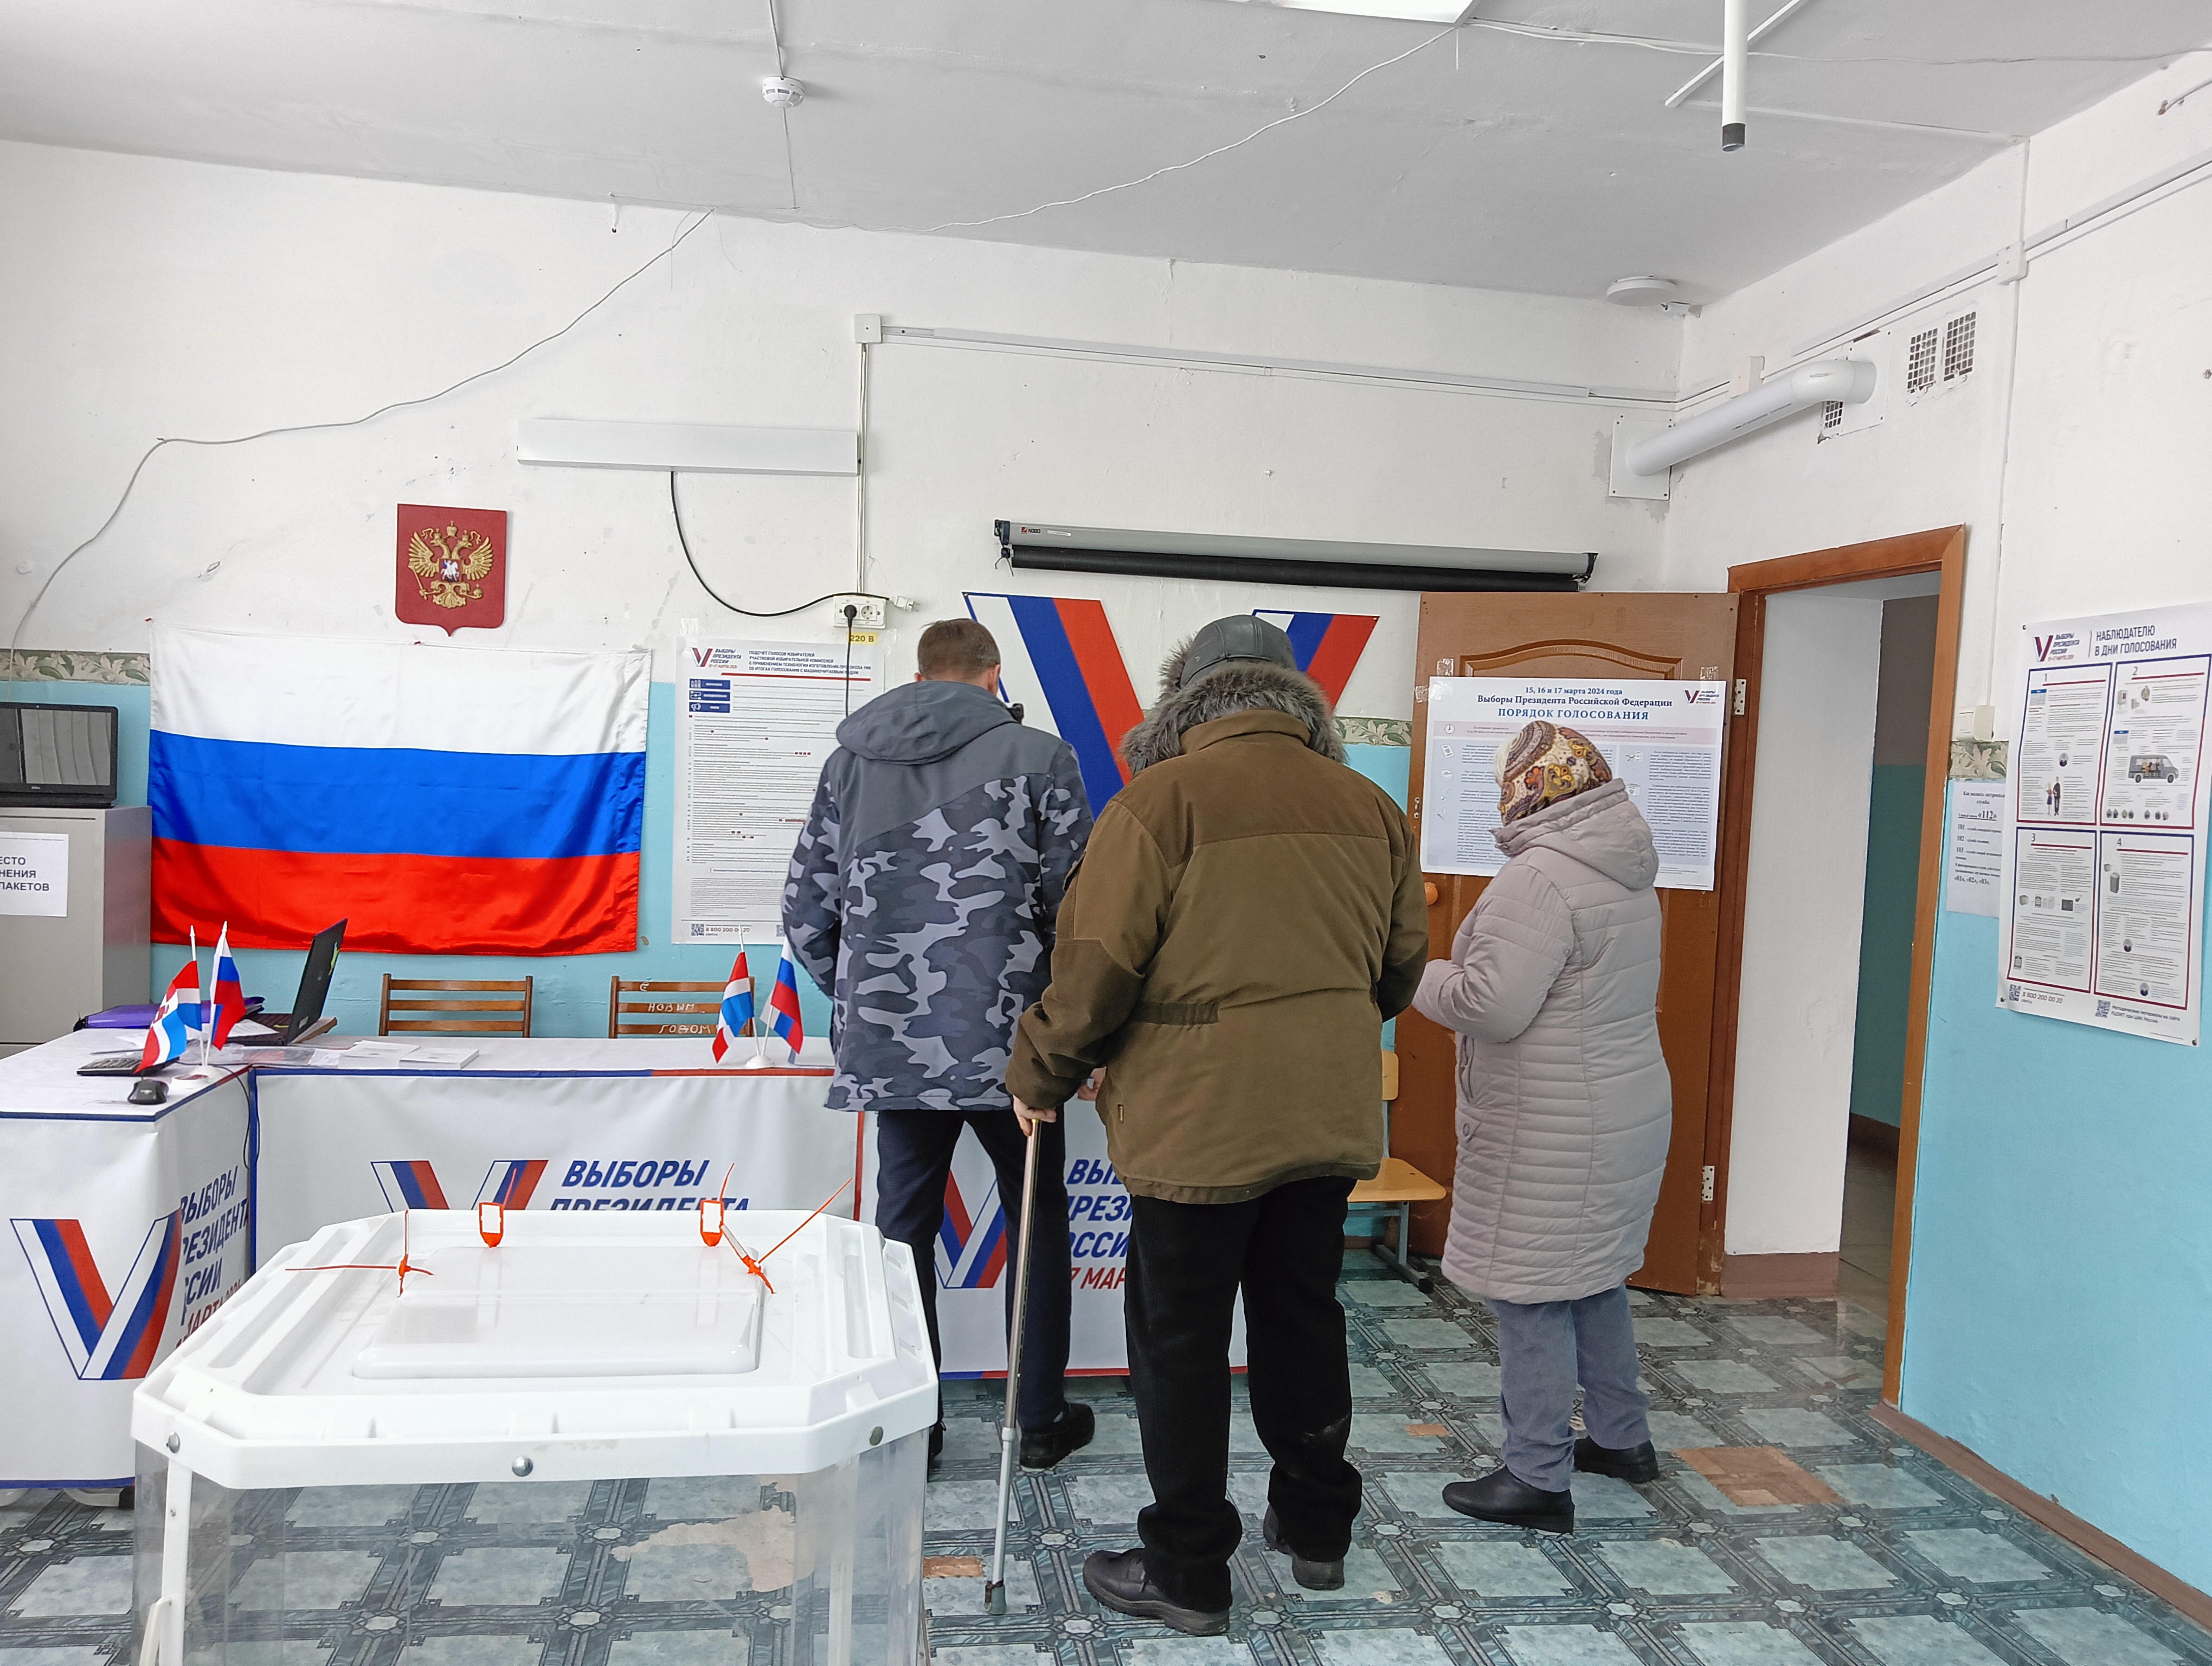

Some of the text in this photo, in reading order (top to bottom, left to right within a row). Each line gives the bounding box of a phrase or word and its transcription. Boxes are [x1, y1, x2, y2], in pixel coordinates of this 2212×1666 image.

[2096, 625, 2155, 641] НАБЛЮДАТЕЛЮ
[2094, 638, 2177, 657] В ДНИ ГОЛОСОВАНИЯ
[2132, 667, 2138, 676] 2
[1477, 695, 1673, 708] Выборы Президента Российской Федерации
[1498, 708, 1649, 720] ПОРЯДОК ГОЛОСОВАНИЯ
[1978, 810, 1997, 819] «112»
[2030, 834, 2036, 842] 3
[2117, 838, 2121, 847] 4
[0, 856, 26, 865] СТО
[561, 1159, 710, 1188] ВЫБОРЫ
